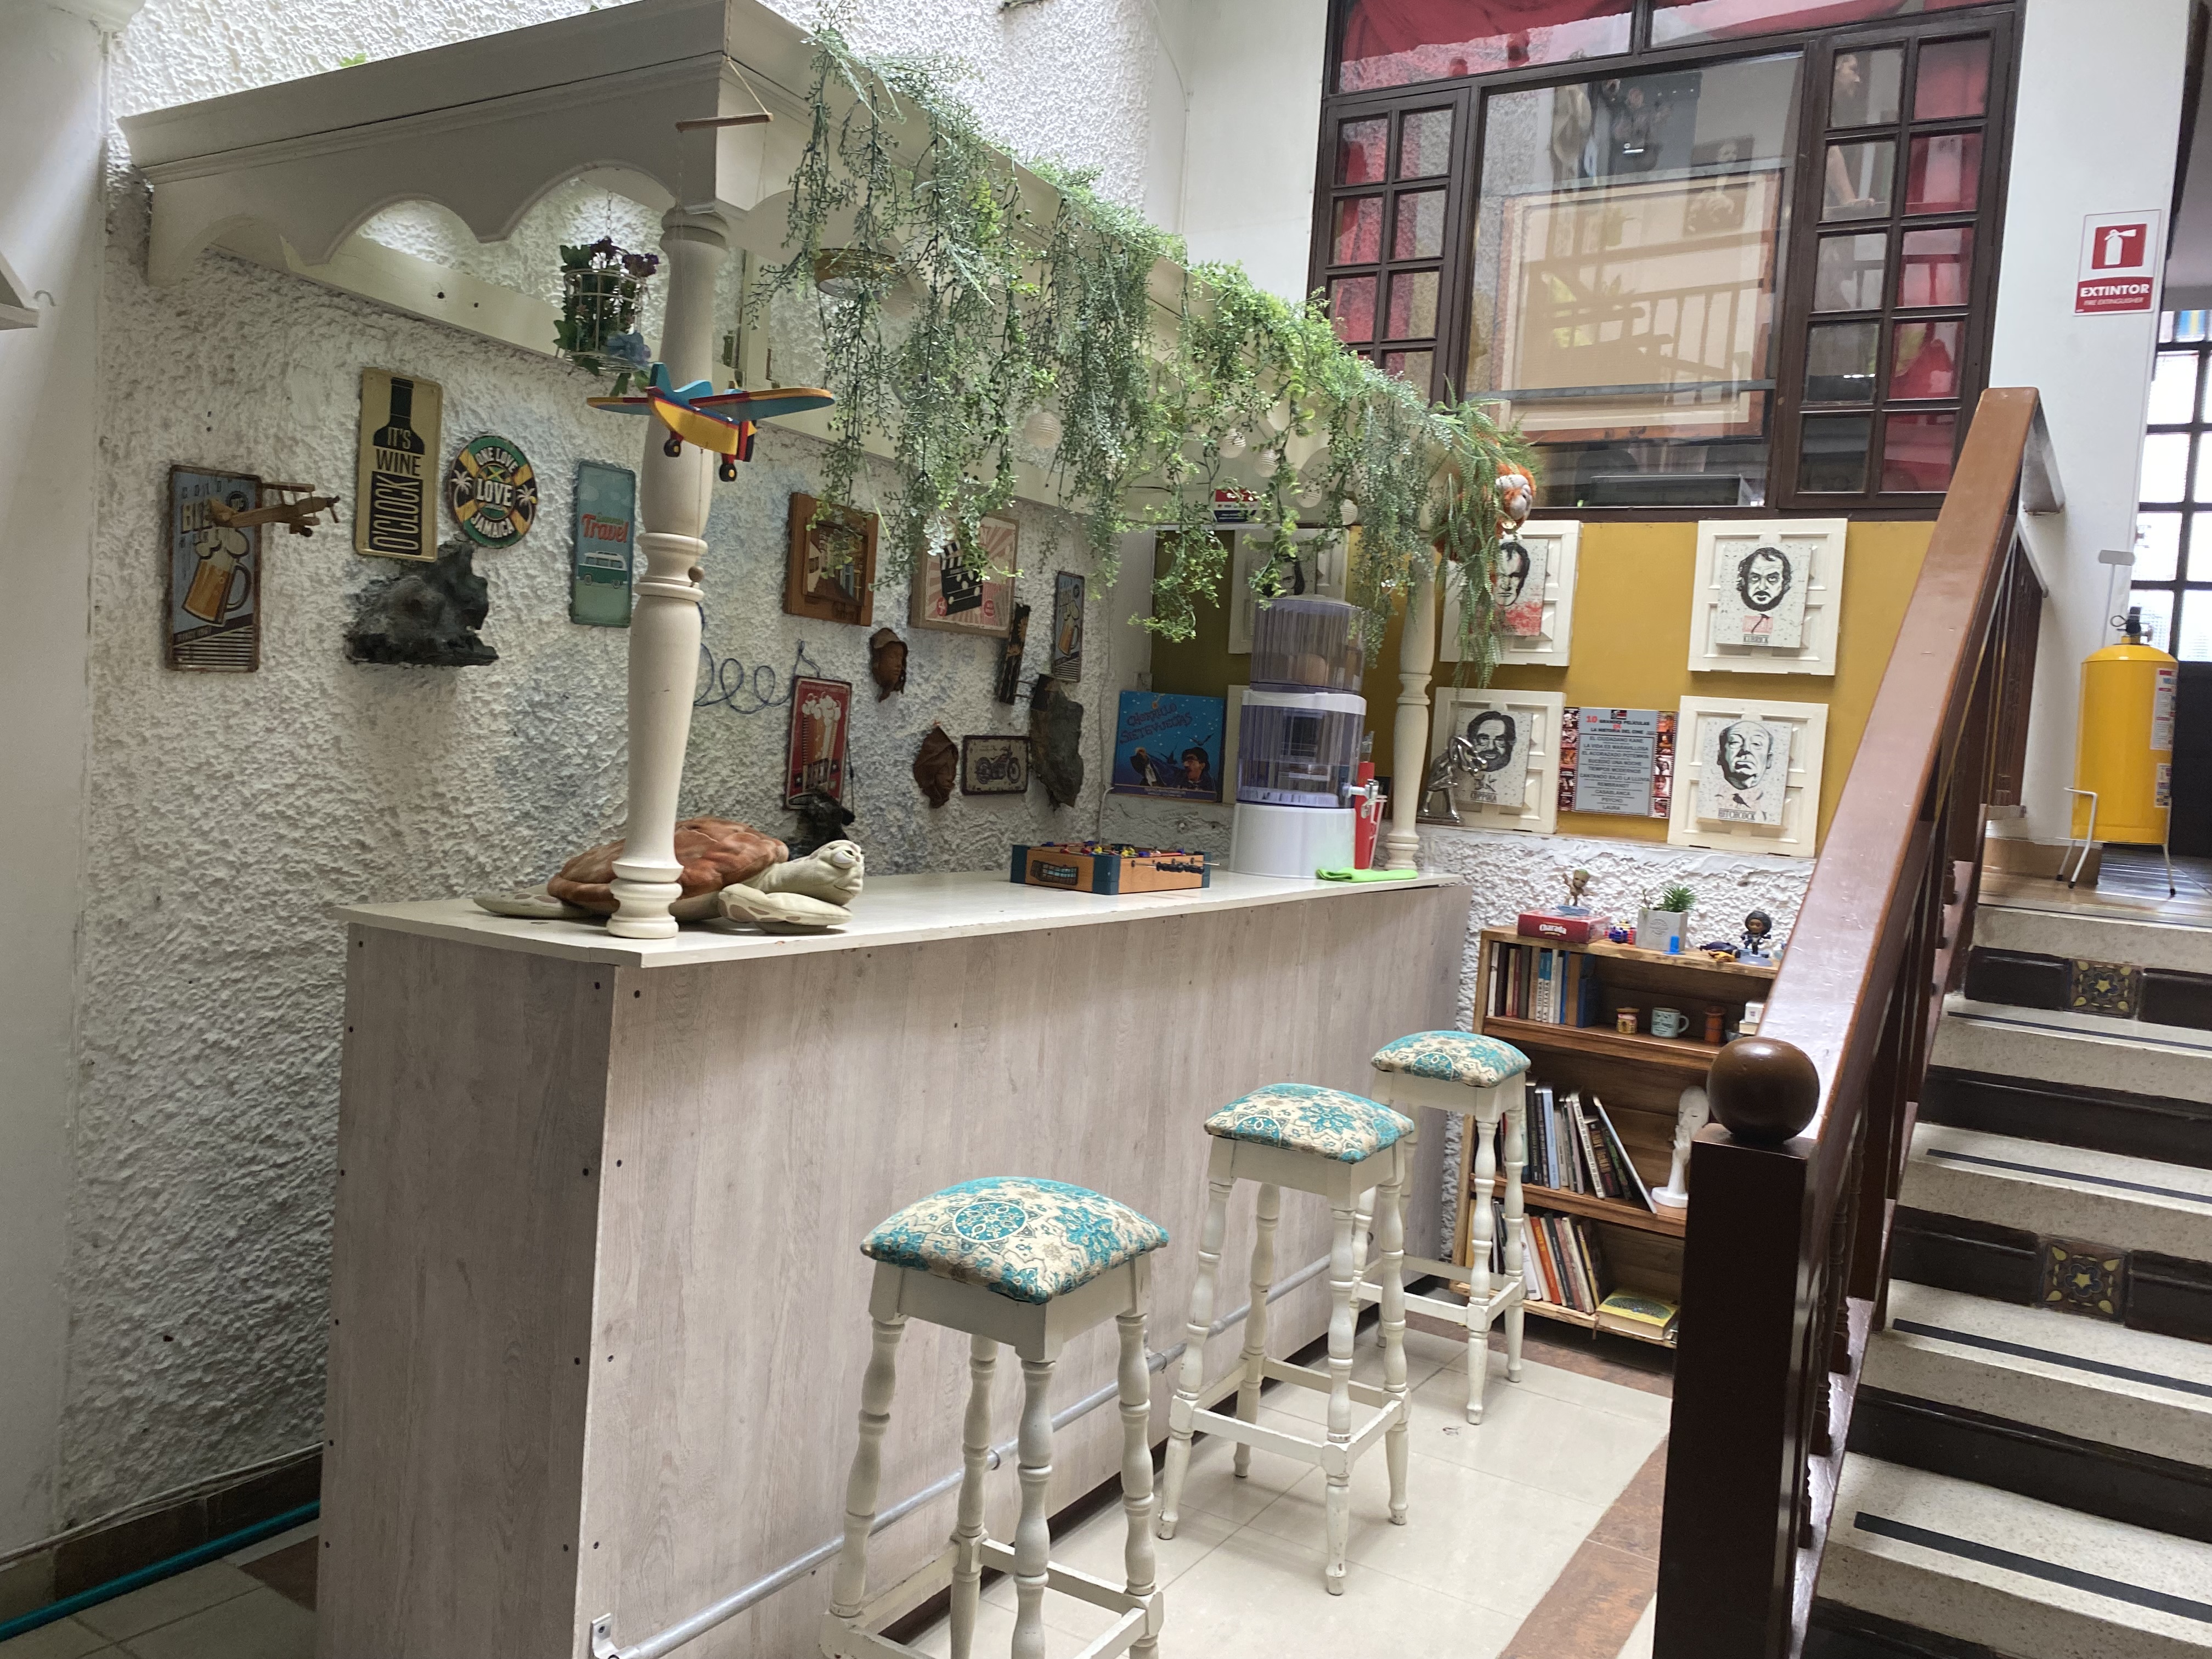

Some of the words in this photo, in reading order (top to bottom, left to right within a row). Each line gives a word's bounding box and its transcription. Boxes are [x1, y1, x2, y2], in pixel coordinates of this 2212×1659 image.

[2080, 284, 2149, 297] EXTINTOR
[387, 427, 411, 450] IT'S
[376, 448, 421, 477] WINE
[475, 447, 494, 466] ONE
[495, 447, 518, 473] LOVE
[476, 478, 512, 507] LOVE
[371, 475, 420, 550] O'CLOCK
[471, 513, 515, 538] JAMAICA
[581, 514, 629, 543] Travel
[1586, 715, 1598, 724] 10
